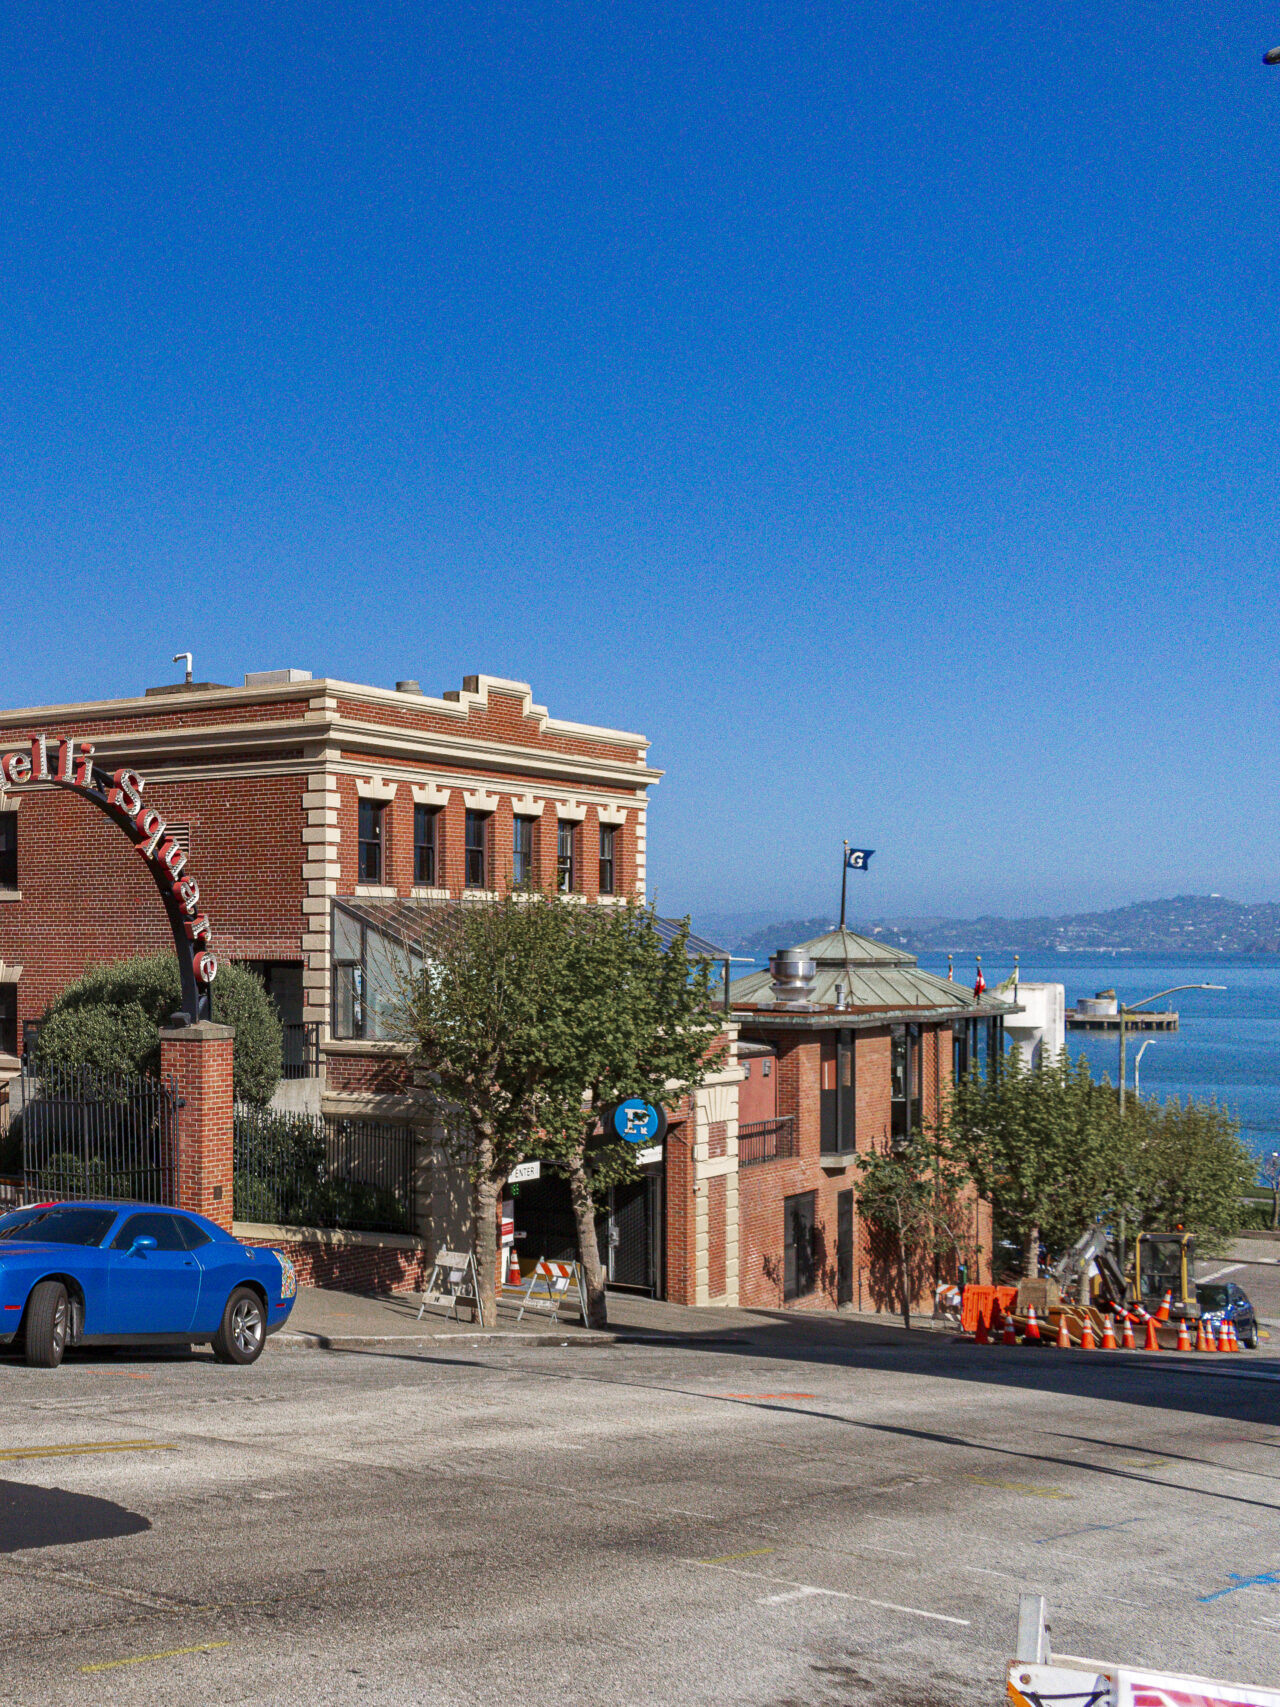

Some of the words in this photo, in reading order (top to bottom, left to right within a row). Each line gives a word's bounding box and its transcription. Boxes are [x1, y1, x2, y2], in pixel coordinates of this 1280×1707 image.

[850, 851, 865, 867] G
[108, 768, 218, 982] Square
[515, 1166, 535, 1179] ENTER
